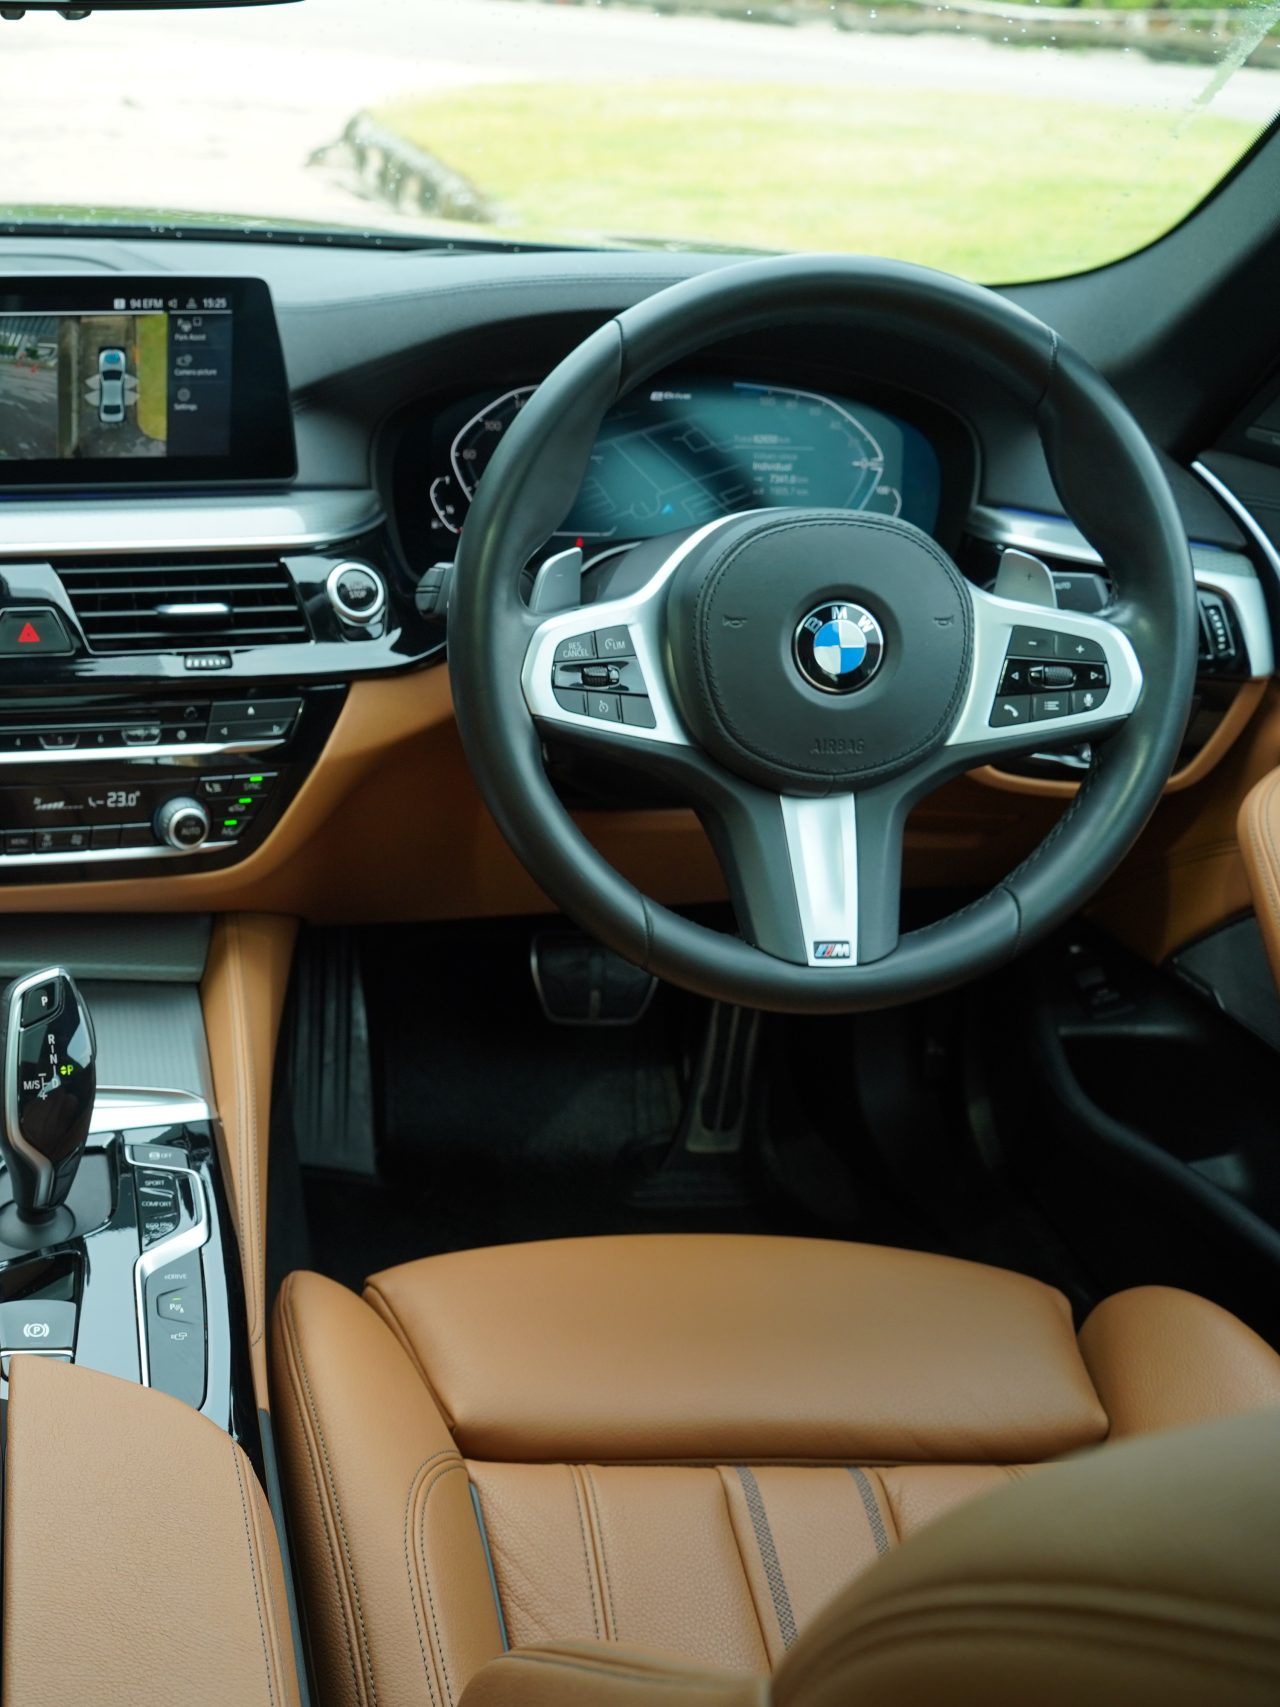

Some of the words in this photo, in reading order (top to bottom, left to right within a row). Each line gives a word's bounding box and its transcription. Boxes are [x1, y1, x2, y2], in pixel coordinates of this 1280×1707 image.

[804, 606, 874, 634] BMW
[612, 640, 626, 650] LIM
[562, 649, 589, 658] CANCEL
[810, 738, 865, 755] AIRBAG
[181, 826, 201, 836] AUTO
[41, 996, 48, 1007] P
[47, 1034, 55, 1045] R
[49, 1054, 58, 1064] N
[67, 1064, 74, 1076] P
[23, 1080, 40, 1090] M/S
[51, 1079, 59, 1089] D
[141, 1200, 173, 1208] COMFORT
